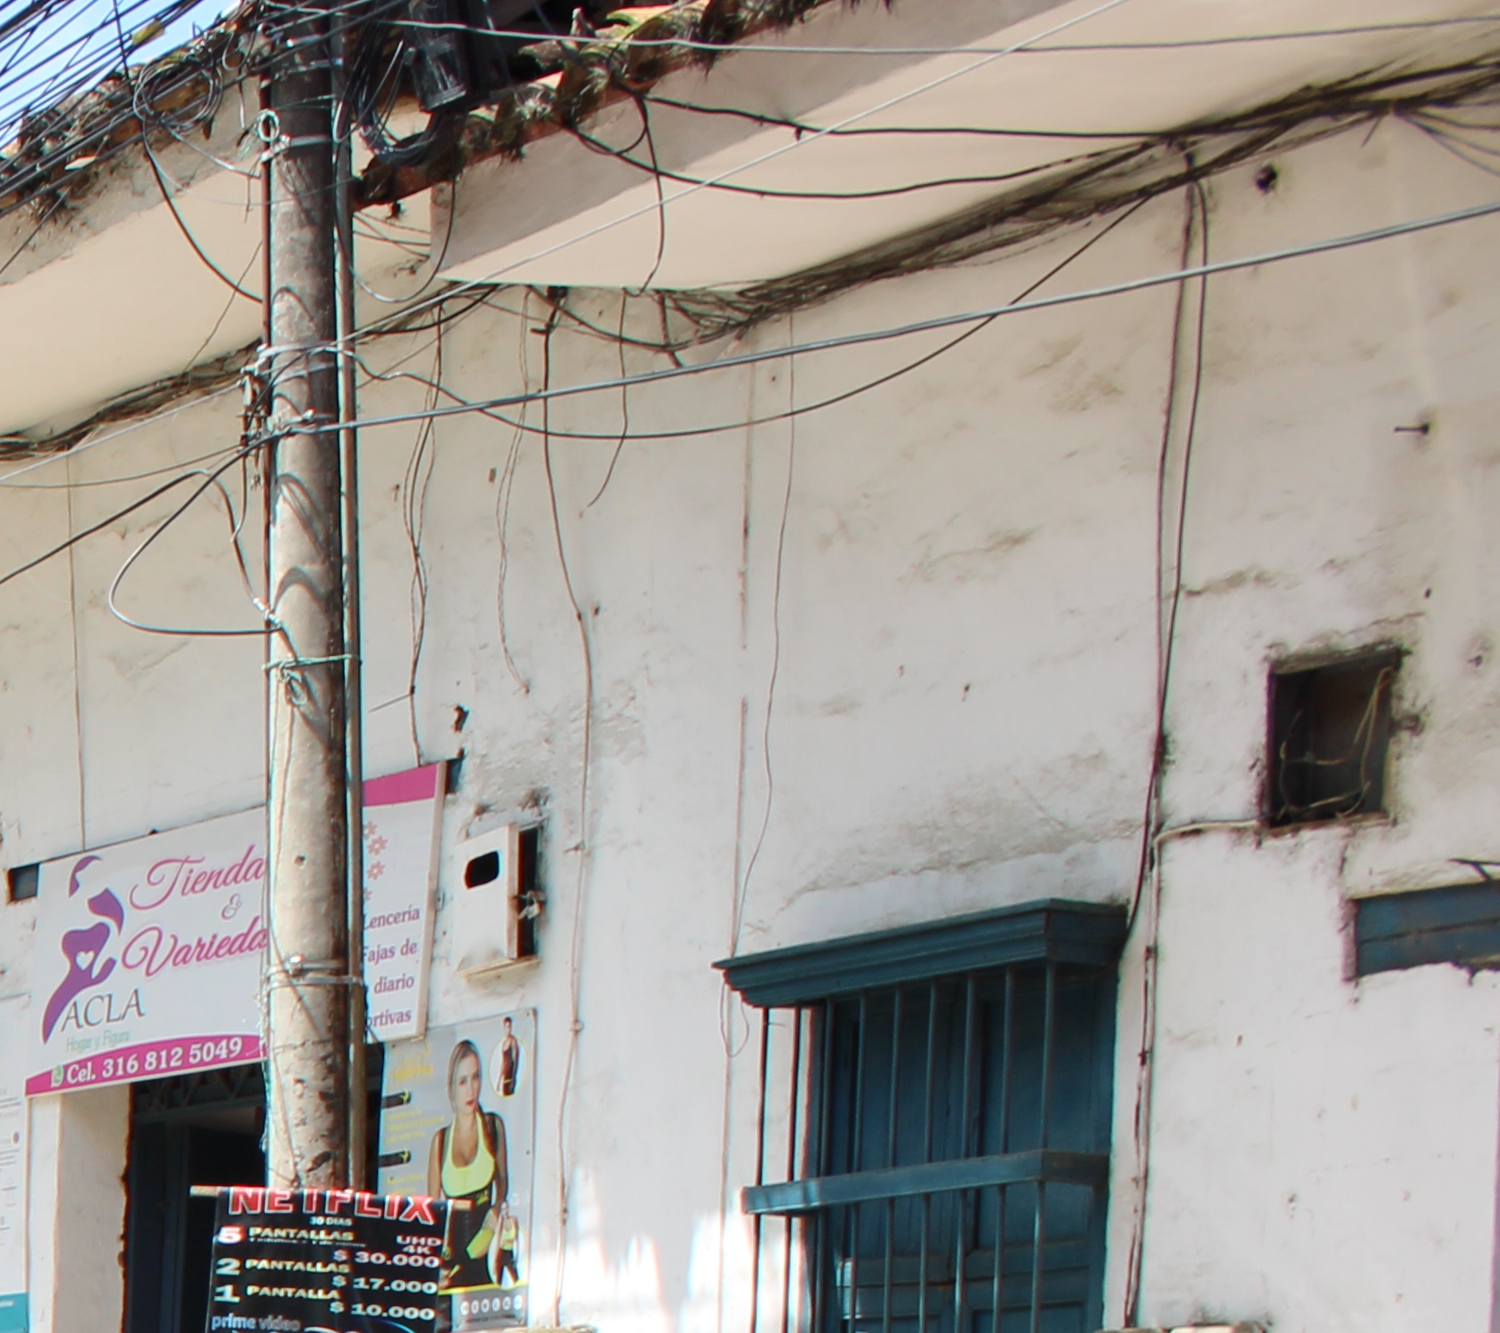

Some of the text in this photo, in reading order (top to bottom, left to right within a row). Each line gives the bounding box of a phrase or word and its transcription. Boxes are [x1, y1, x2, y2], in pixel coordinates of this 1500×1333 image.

[129, 844, 268, 911] Tienda
[121, 915, 269, 977] Varieda
[399, 937, 418, 957] de
[373, 973, 415, 995] diario
[60, 987, 146, 1033] ACLA
[367, 1008, 413, 1029] ortivas
[66, 1037, 243, 1083] Cel. 316 812 5049
[228, 1186, 434, 1225] NETFLIX
[217, 1226, 245, 1244] 5
[249, 1227, 355, 1242] PANTALLAS
[396, 1235, 442, 1247] UHD
[216, 1257, 350, 1276] 2 PANTALLAS
[354, 1251, 441, 1269] 30.000
[213, 1284, 341, 1303] 1 PANTALLA
[353, 1277, 439, 1295] 17.000
[351, 1303, 437, 1321] 10.000
[211, 1316, 257, 1331] prime
